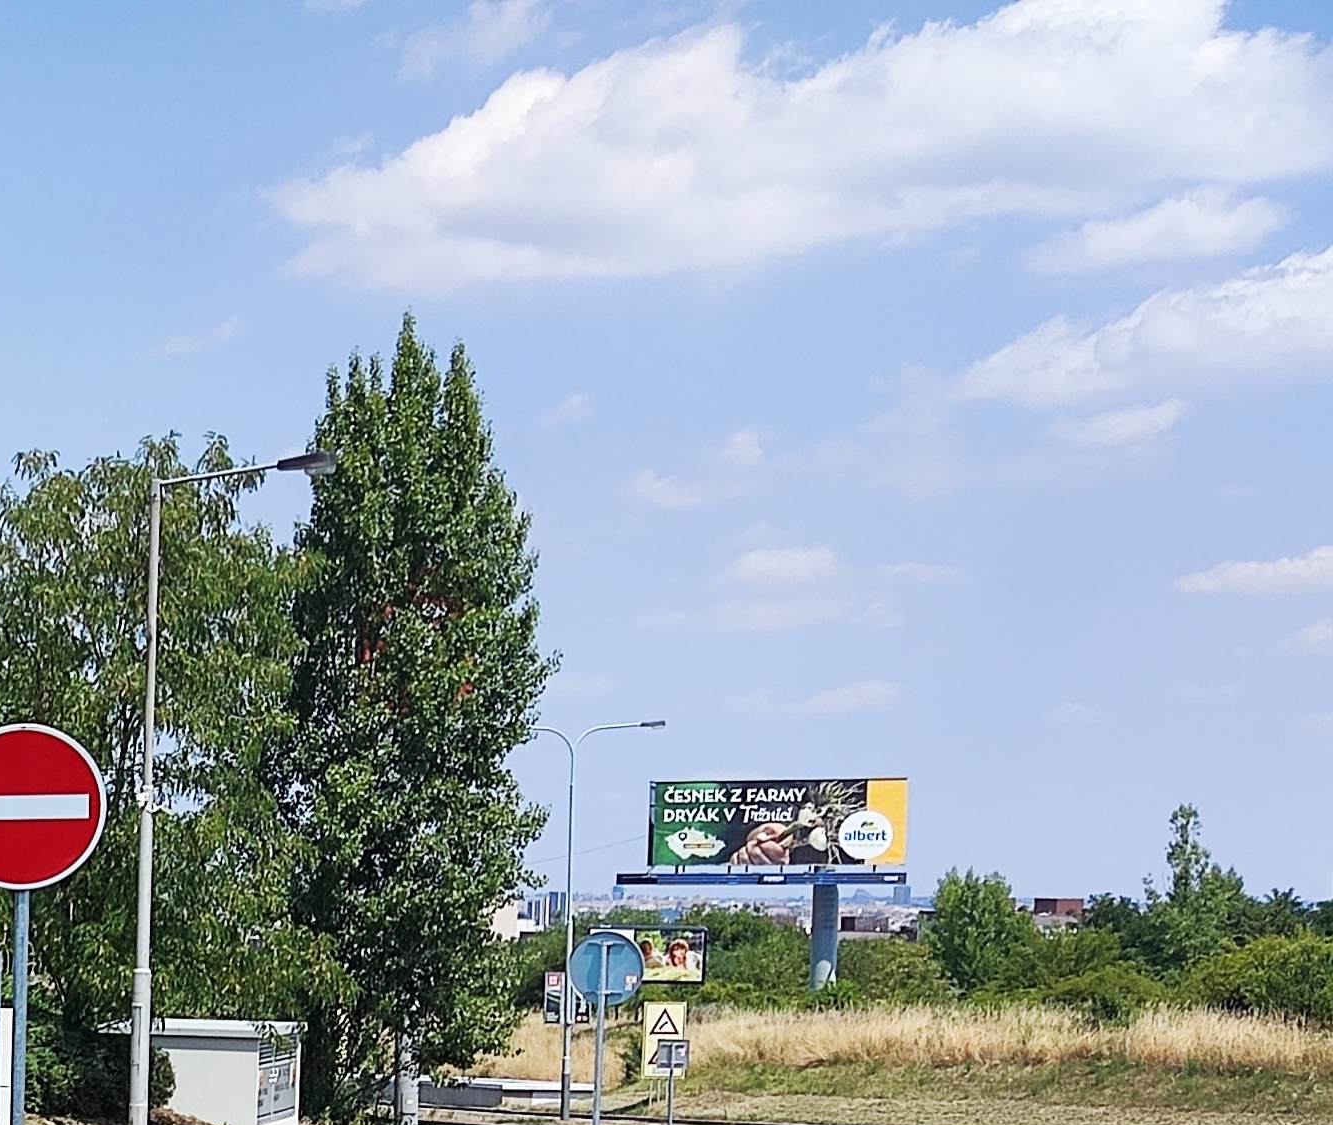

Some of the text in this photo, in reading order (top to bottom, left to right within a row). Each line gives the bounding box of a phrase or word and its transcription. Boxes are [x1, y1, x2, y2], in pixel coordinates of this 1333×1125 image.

[664, 786, 806, 803] ČESNEK Z FARMY
[664, 805, 719, 822] DRYÁK
[723, 808, 736, 821] V
[844, 830, 887, 841] albert
